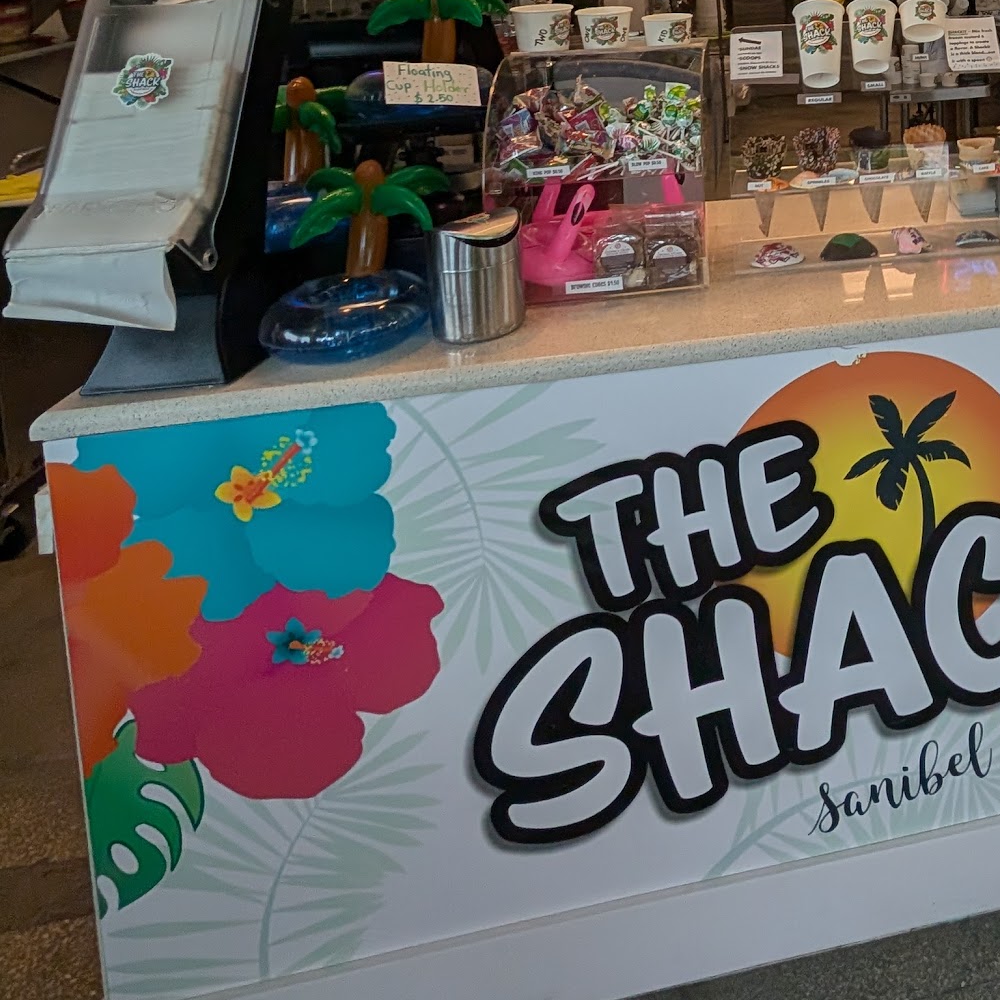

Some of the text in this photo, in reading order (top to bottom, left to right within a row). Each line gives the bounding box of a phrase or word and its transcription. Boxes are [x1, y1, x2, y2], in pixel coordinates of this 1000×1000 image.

[125, 76, 162, 88] SHACK
[397, 63, 454, 83] Floating
[386, 80, 412, 94] Cup
[540, 420, 834, 612] THE
[808, 720, 996, 837] Sanibel
